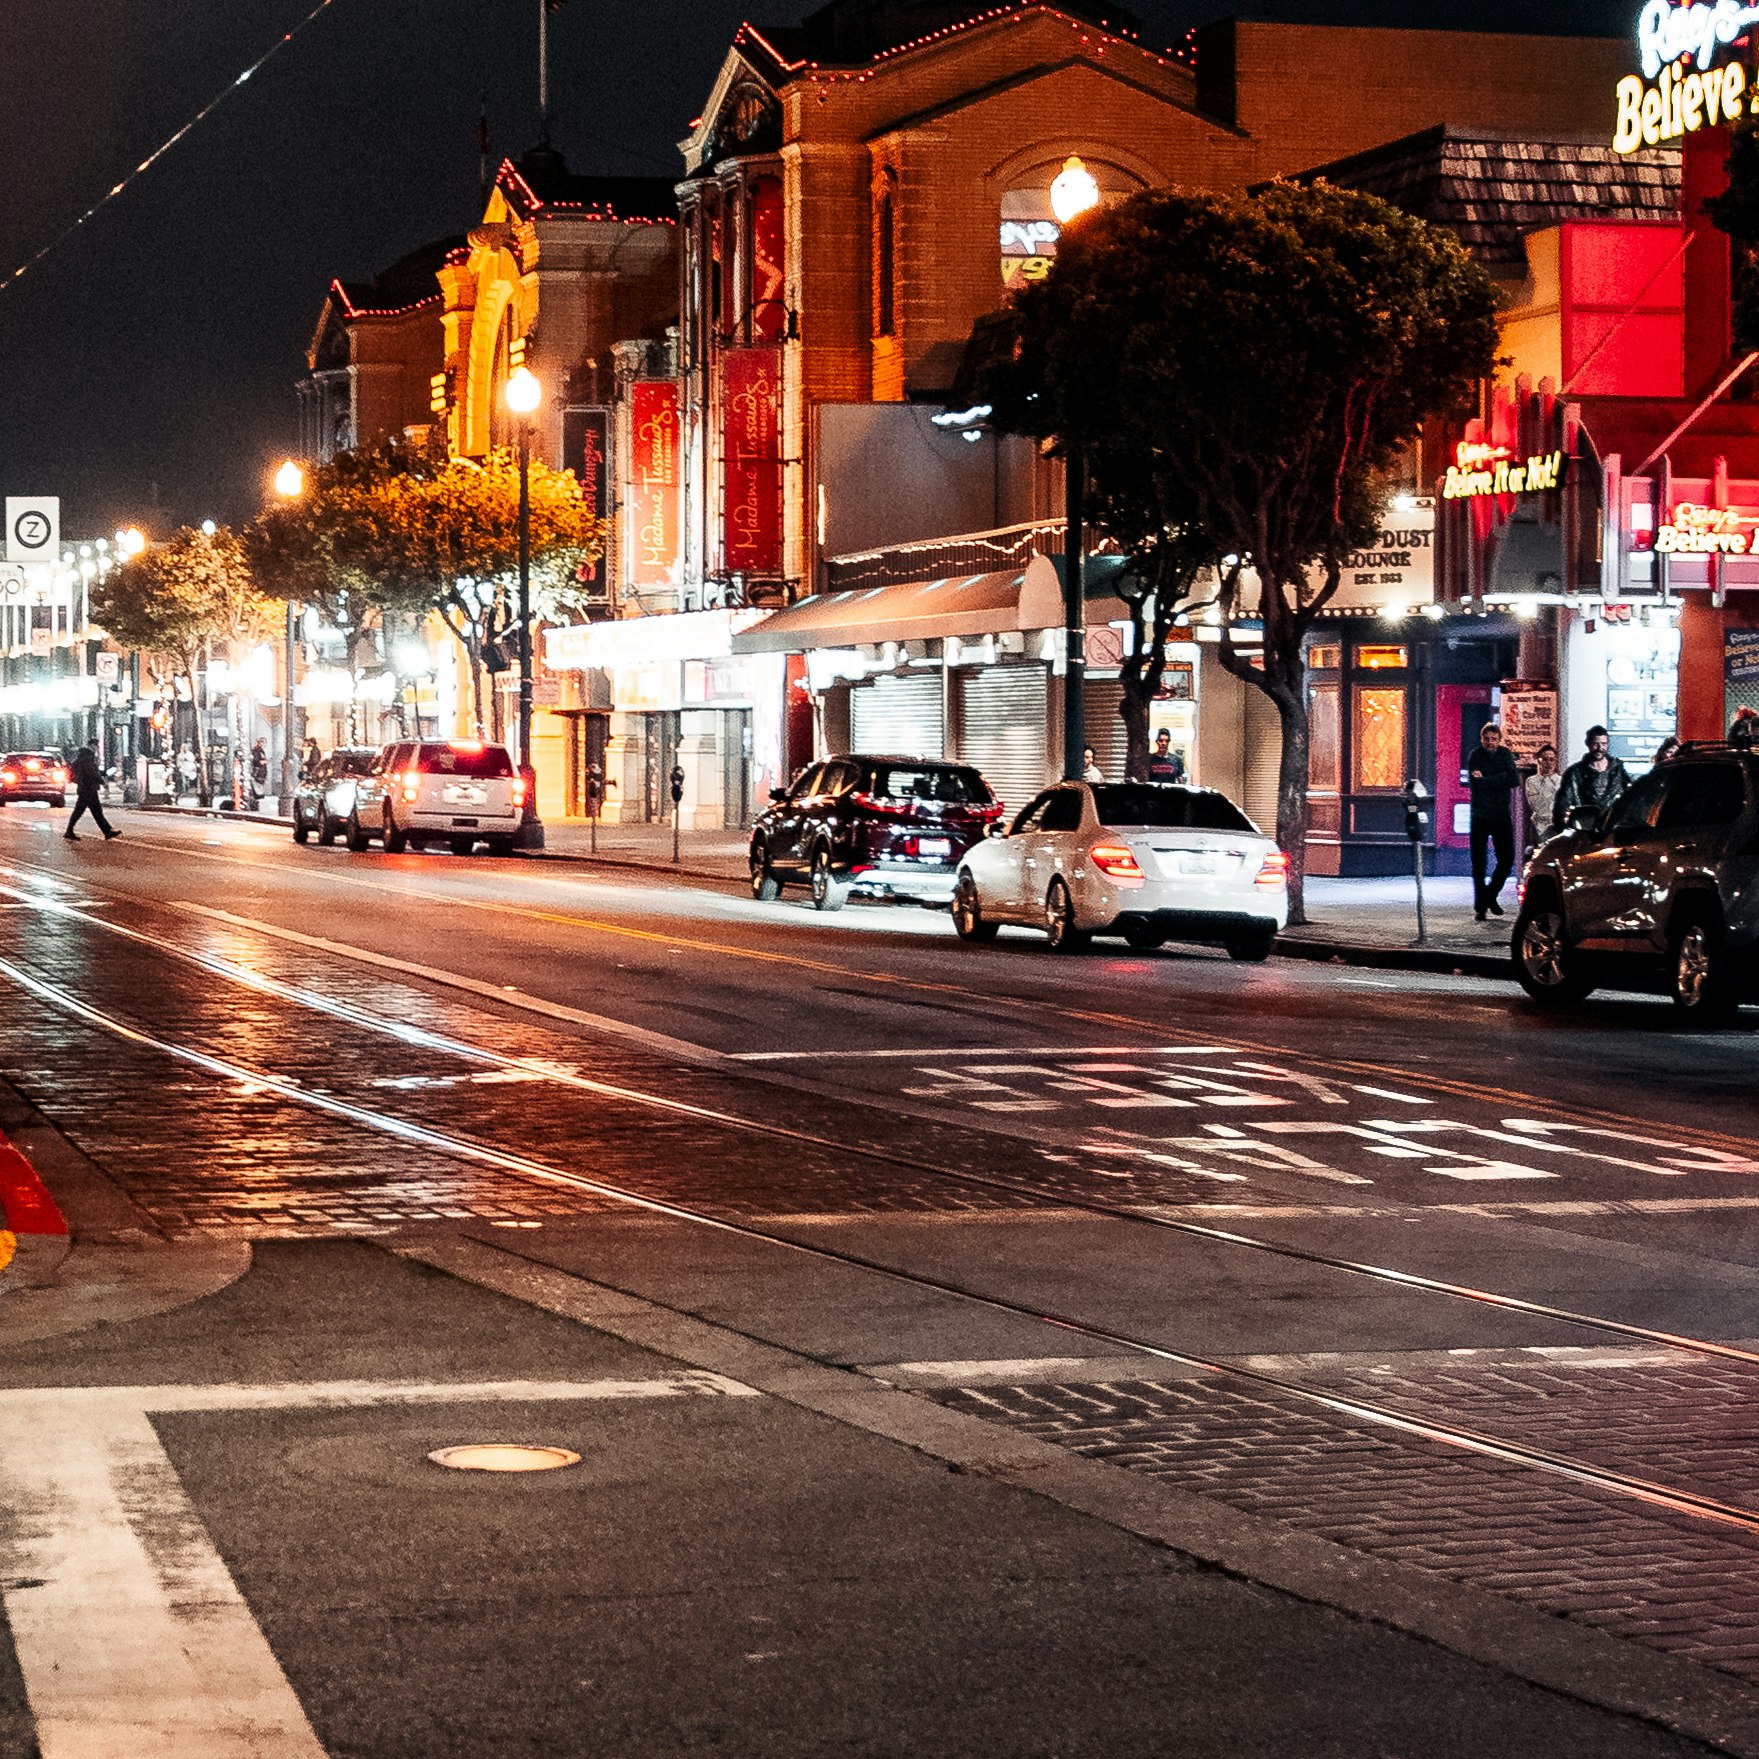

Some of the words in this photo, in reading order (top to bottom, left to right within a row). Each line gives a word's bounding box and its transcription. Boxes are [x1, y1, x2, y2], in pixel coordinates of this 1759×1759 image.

[1613, 61, 1745, 155] Believe
[640, 408, 674, 495] Tussauds
[732, 378, 769, 471] Tussauds
[732, 465, 762, 549] Madame
[1525, 449, 1562, 491] Not!
[640, 488, 667, 566] Madame
[1343, 550, 1412, 569] LOUNGE
[1381, 529, 1435, 548] DUST
[1654, 525, 1746, 554] Believe
